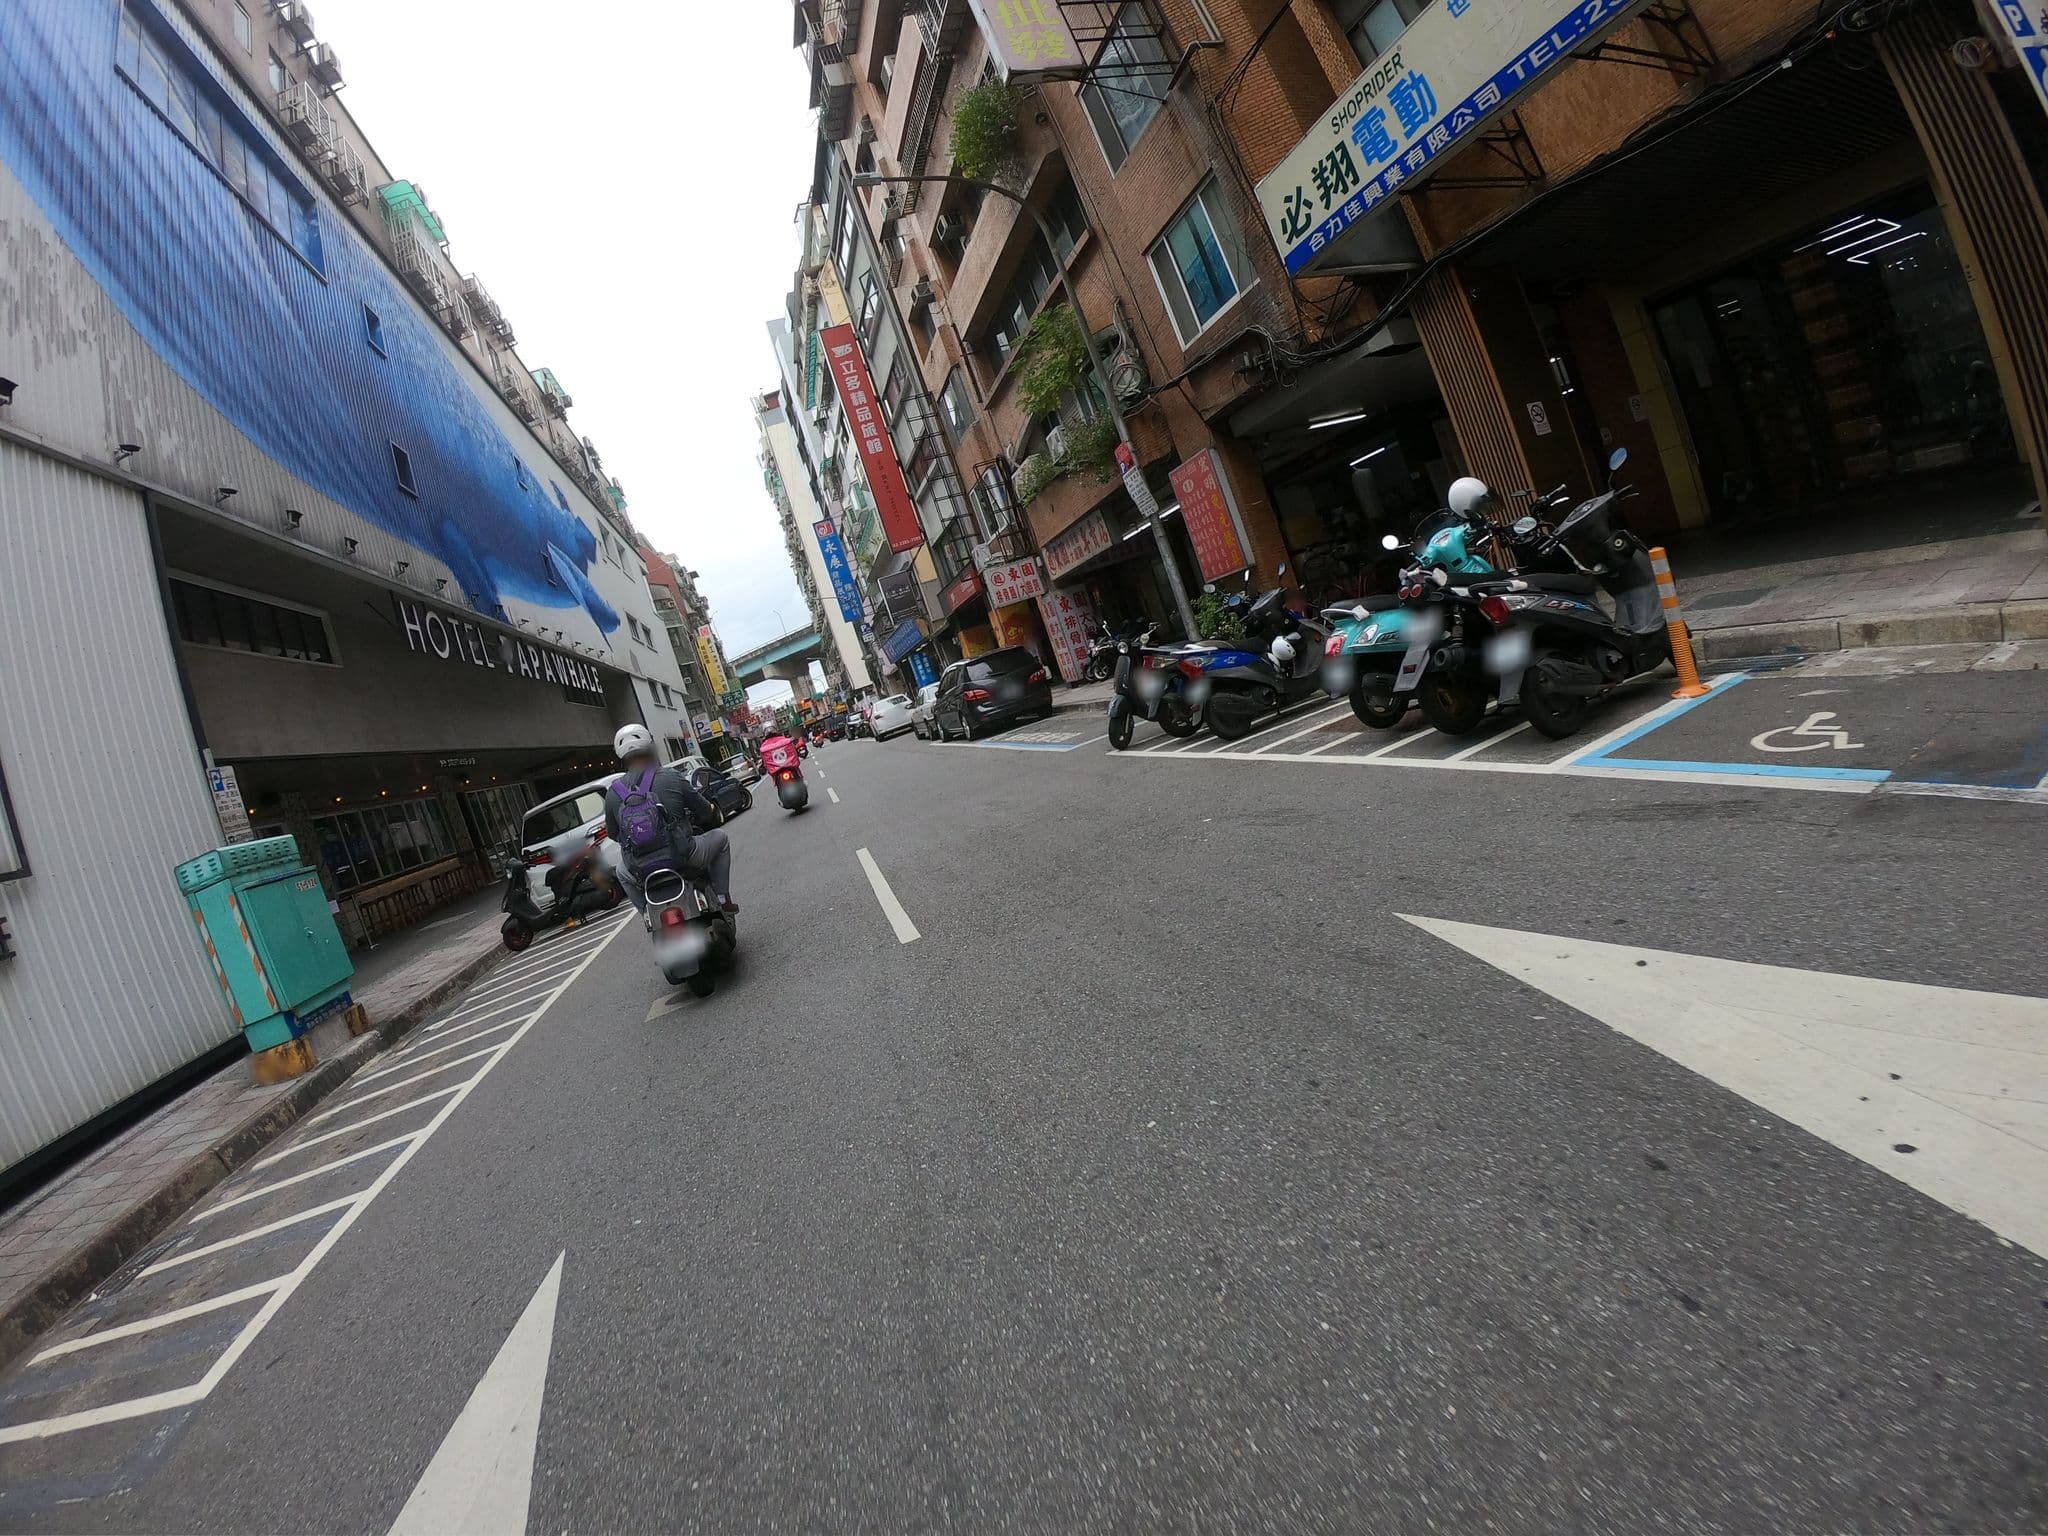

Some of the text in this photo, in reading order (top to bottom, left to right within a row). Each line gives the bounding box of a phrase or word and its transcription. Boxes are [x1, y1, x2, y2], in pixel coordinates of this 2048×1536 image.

[1331, 51, 1405, 135] SHOPRIDER
[1280, 70, 1437, 244] 必翔電動
[1308, 81, 1501, 253] 合力佳興業有限公司
[840, 360, 883, 454] 立多精品旅館
[400, 600, 495, 669] HOTEL
